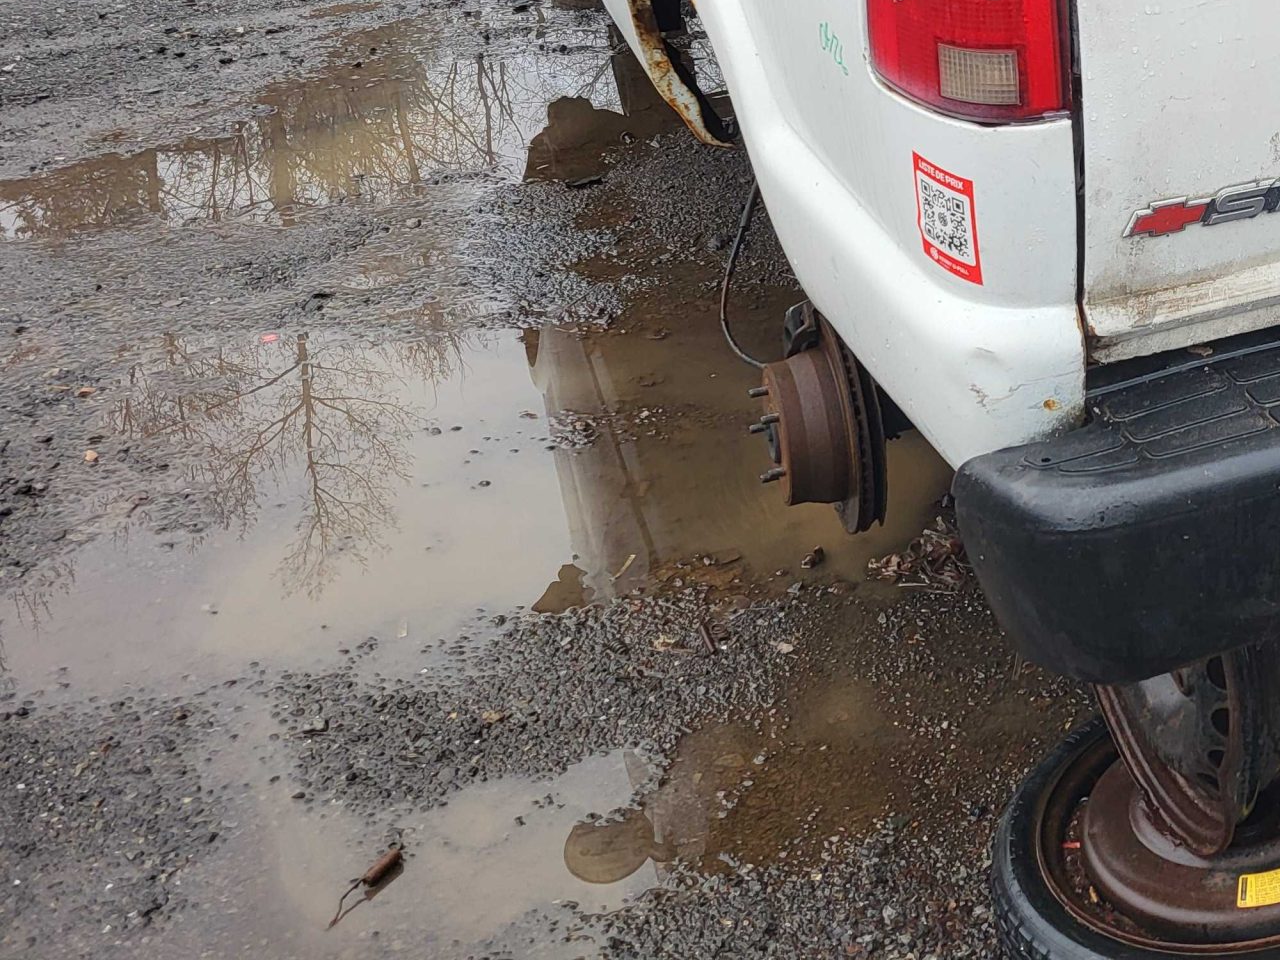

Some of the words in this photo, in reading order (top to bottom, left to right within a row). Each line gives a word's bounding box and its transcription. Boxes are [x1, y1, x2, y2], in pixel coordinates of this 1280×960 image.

[918, 159, 936, 177] LISTE
[935, 170, 946, 183] DE
[946, 175, 964, 190] PRIX
